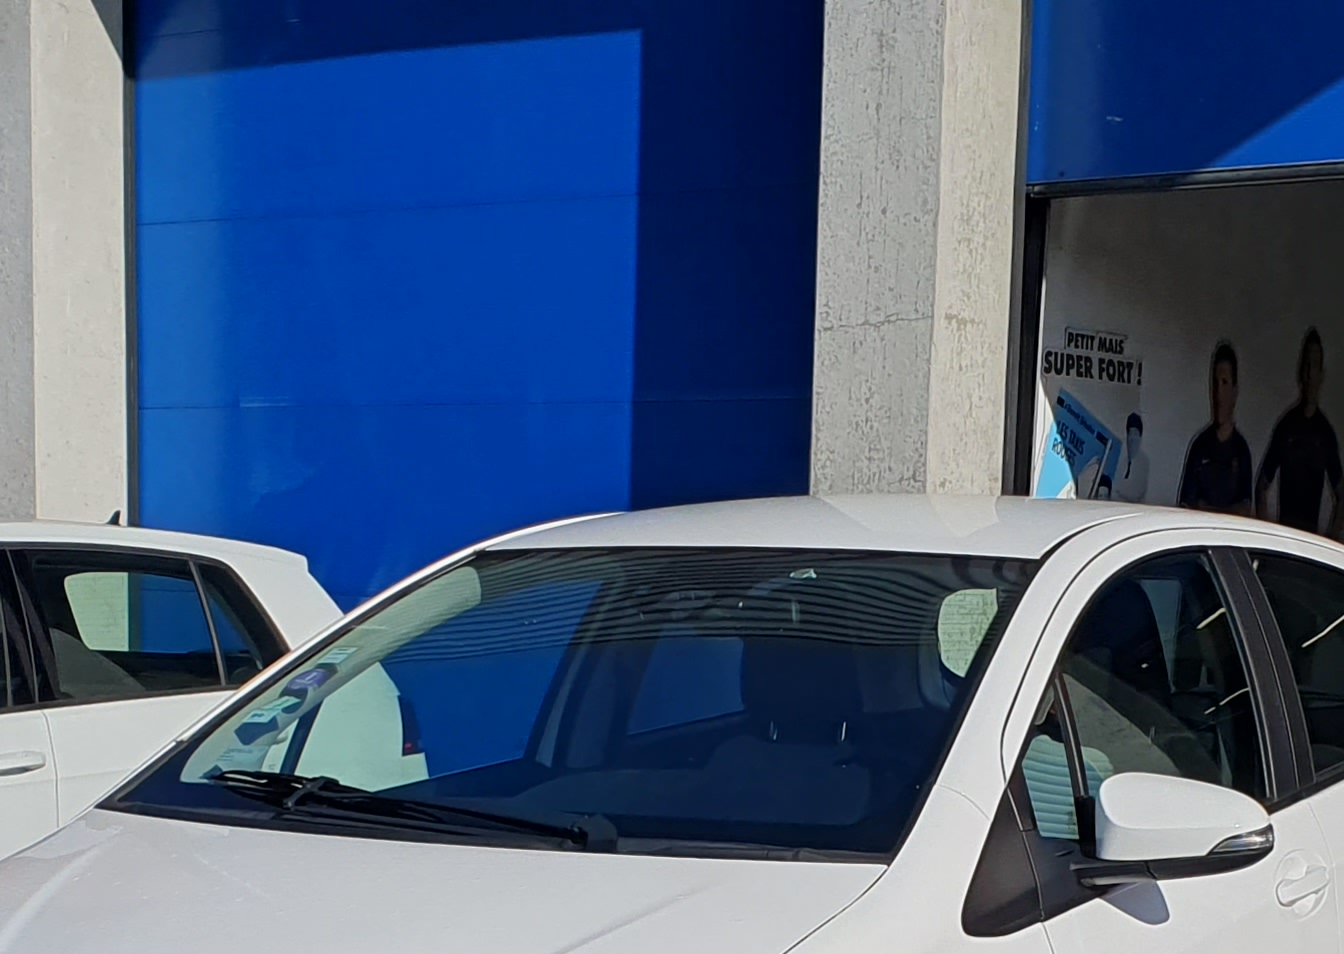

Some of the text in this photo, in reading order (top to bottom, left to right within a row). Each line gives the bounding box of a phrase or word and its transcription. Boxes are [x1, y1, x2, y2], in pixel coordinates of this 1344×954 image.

[1066, 332, 1125, 355] PETIT MAIS
[1043, 350, 1094, 380] SUPER
[1098, 357, 1134, 384] FORT
